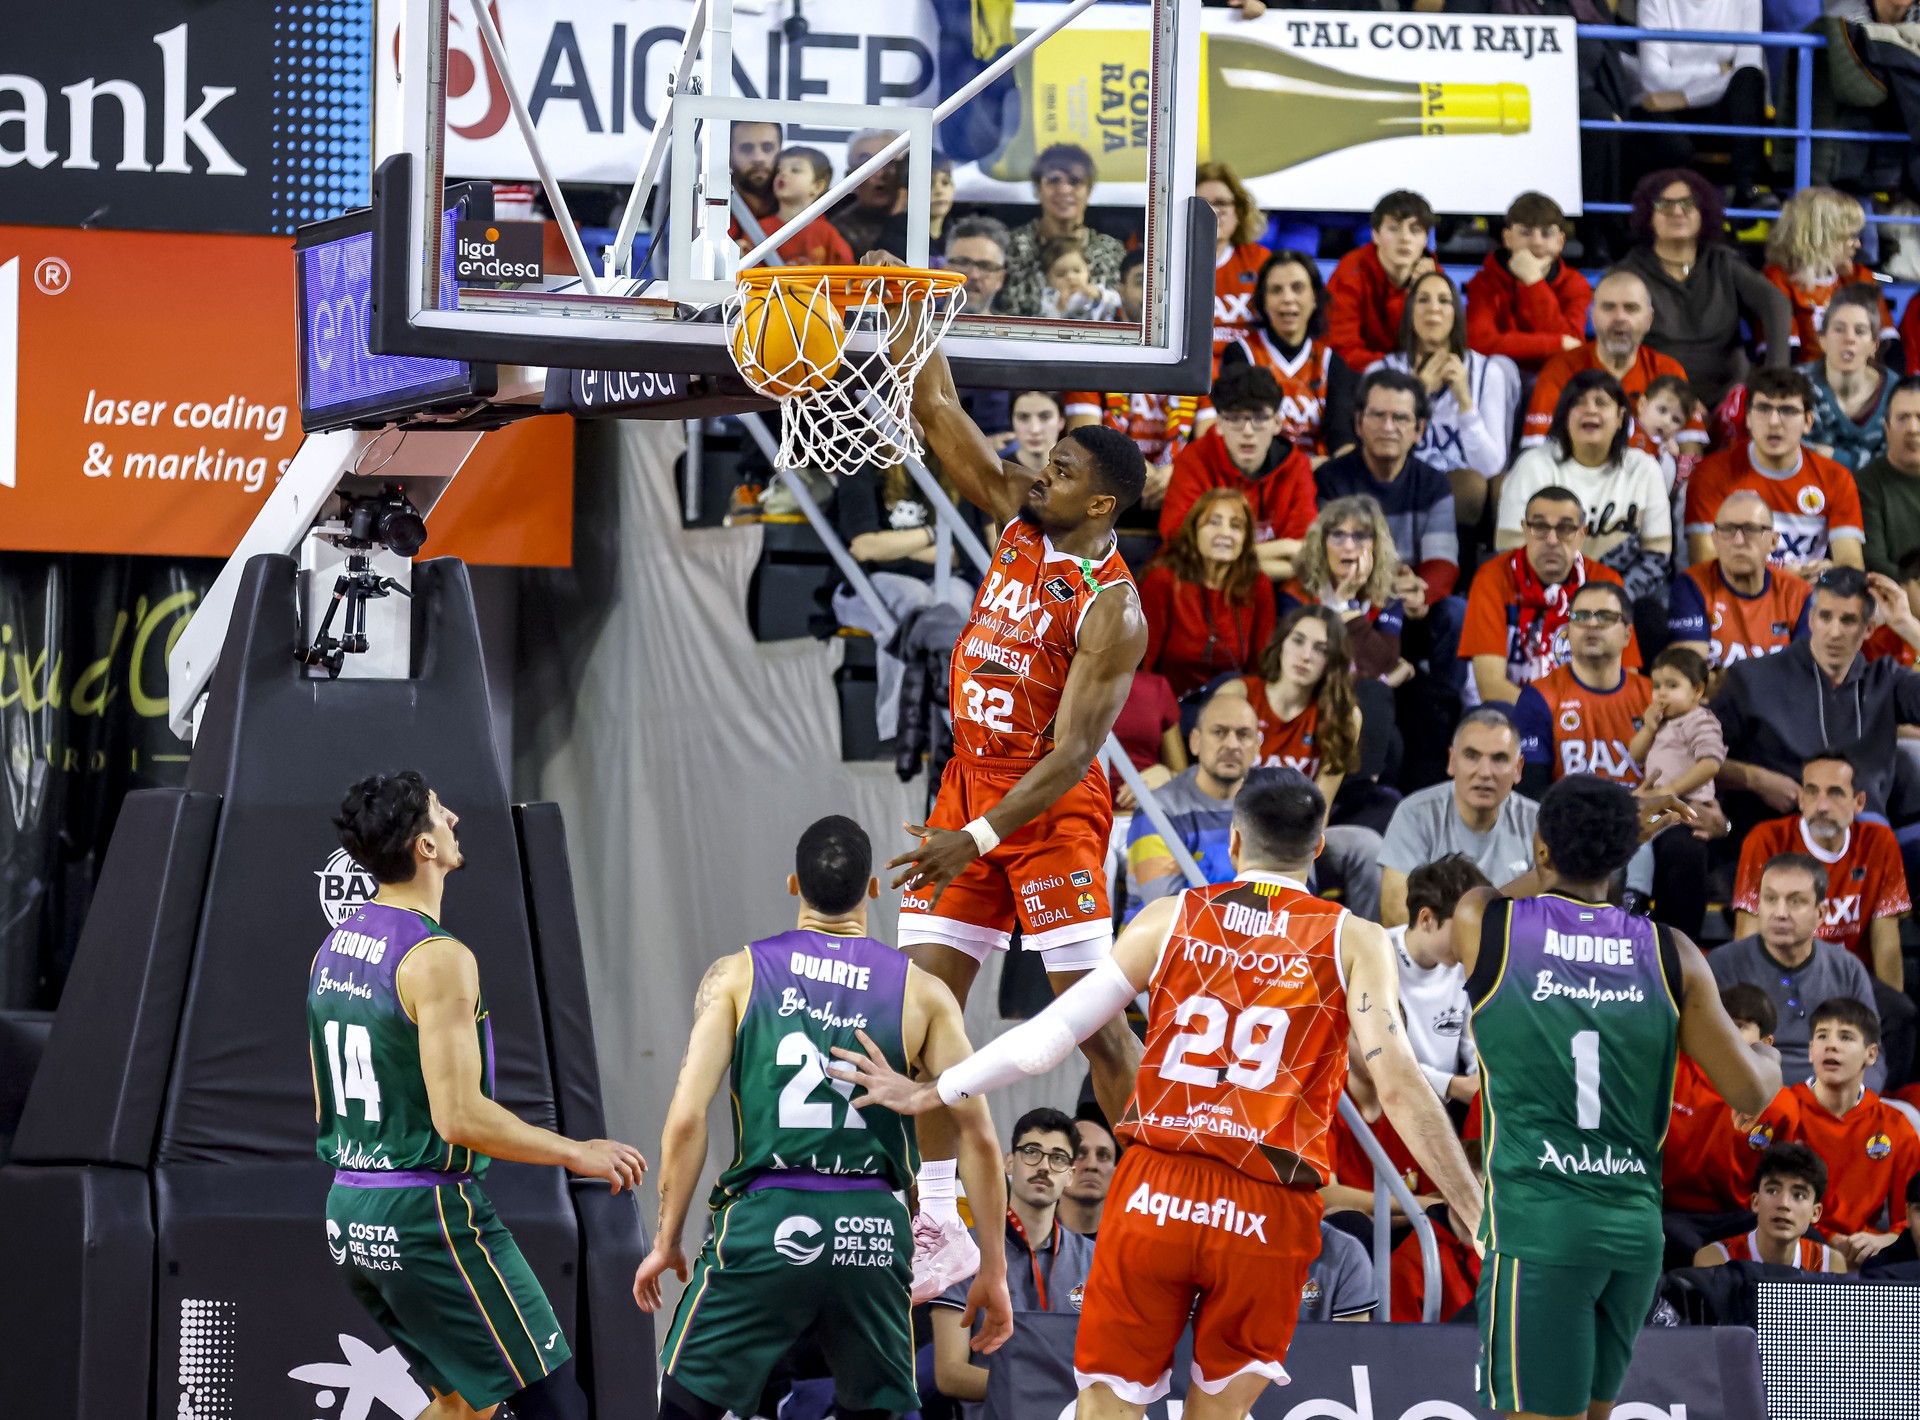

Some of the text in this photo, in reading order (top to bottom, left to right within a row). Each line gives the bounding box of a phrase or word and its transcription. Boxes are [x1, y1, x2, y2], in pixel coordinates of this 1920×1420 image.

[1288, 21, 1563, 60] TAL COM RAJA
[1096, 62, 1126, 153] RAJA
[1427, 82, 1445, 116] AL
[458, 238, 495, 259] liga
[458, 259, 539, 278] endesa
[84, 389, 288, 441] laser coding
[83, 441, 113, 478] &
[123, 445, 268, 493] marking
[964, 635, 1031, 676] MANRESA
[961, 679, 1015, 733] 32
[1024, 895, 1046, 914] ETL
[1029, 906, 1073, 928] GLOBAL
[1223, 902, 1290, 938] ORIOLA
[1543, 928, 1635, 966] AUDIGE
[790, 951, 871, 991] DUARTE
[1158, 995, 1291, 1091] 29
[323, 1020, 381, 1122] 14
[1571, 1030, 1601, 1130] 1
[834, 1216, 894, 1236] COSTA
[1126, 1182, 1267, 1243] Aquaflix
[348, 1222, 400, 1242] COSTA
[348, 1240, 400, 1257] DEL SOL
[833, 1236, 894, 1252] DEL SOL
[352, 1254, 403, 1271] MÁLAGA
[831, 1250, 893, 1267] MÁLAGA
